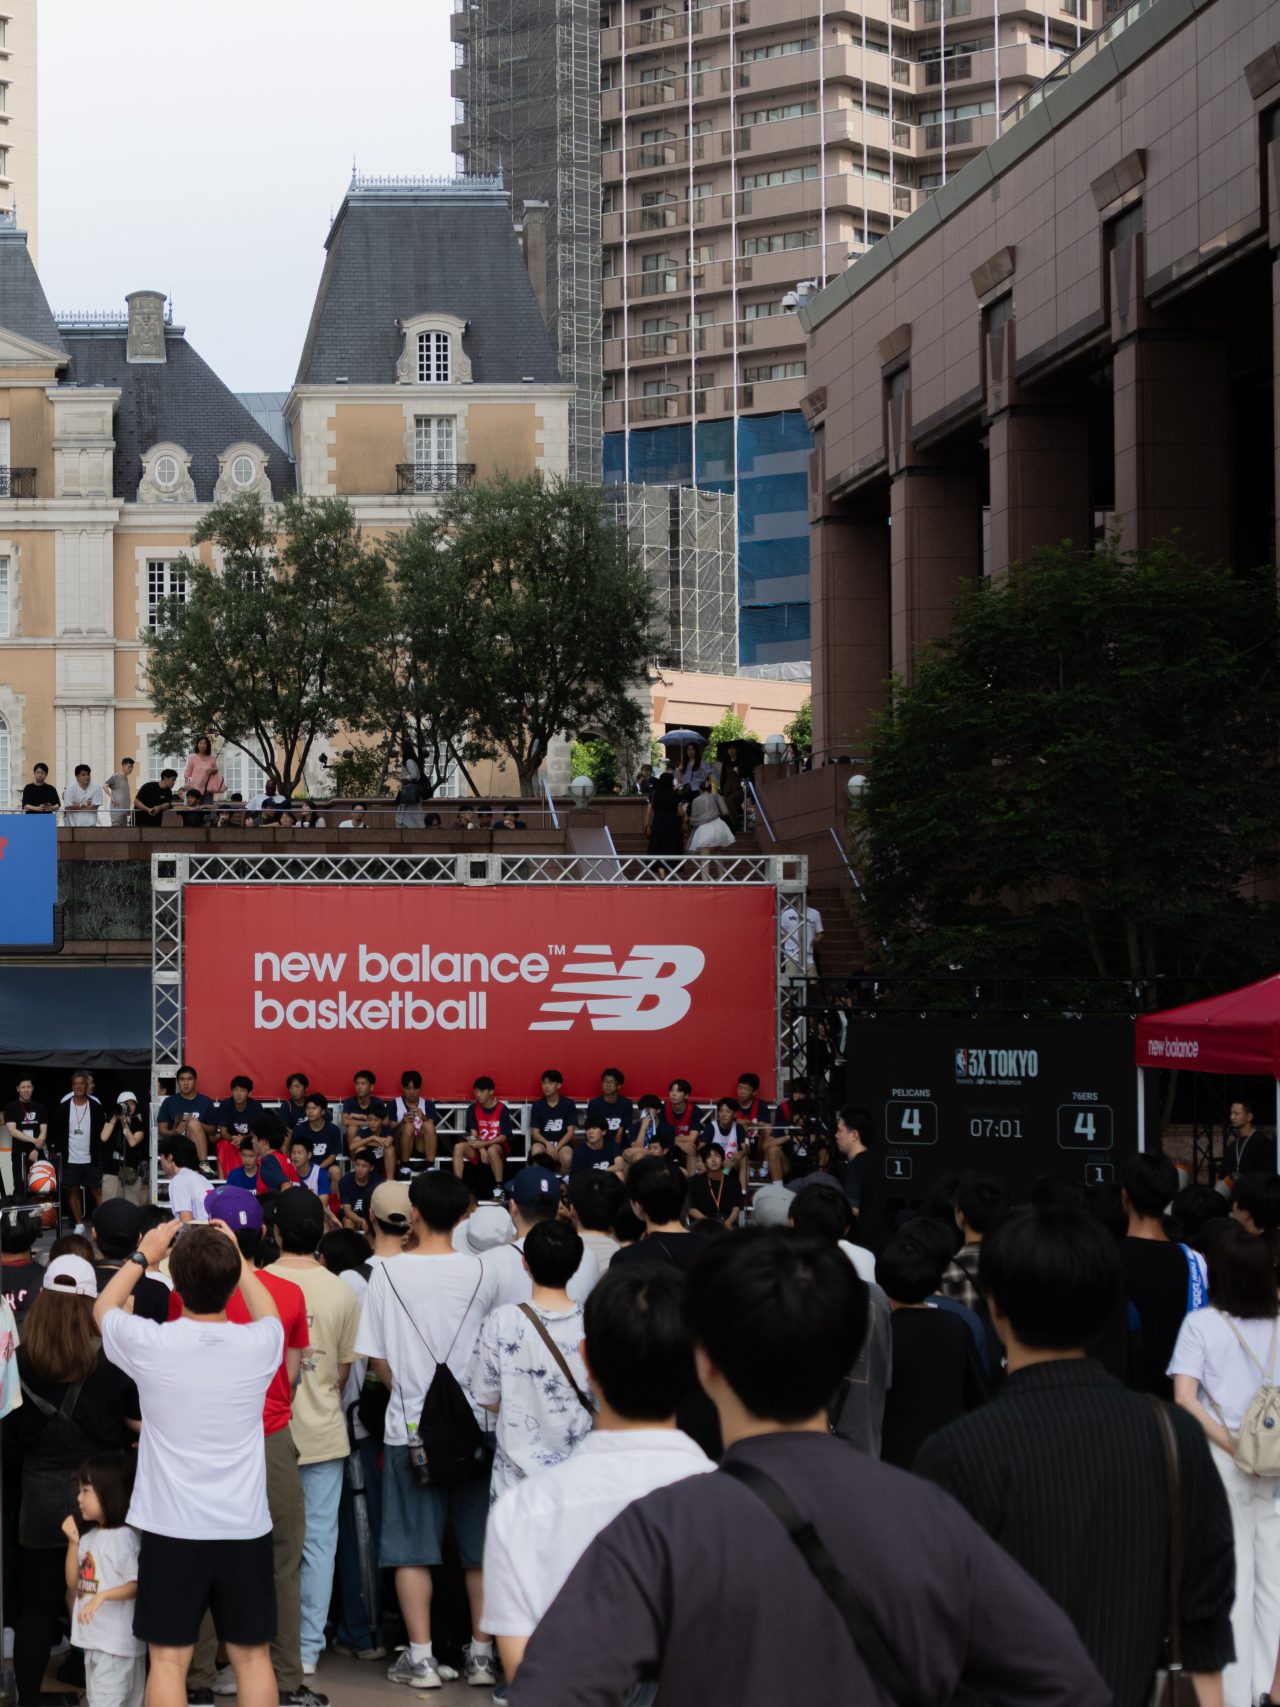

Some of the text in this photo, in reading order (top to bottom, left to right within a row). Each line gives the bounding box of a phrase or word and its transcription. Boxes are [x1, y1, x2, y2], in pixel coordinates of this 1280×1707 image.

[254, 951, 347, 983] new
[254, 991, 487, 1031] basketball
[1148, 1036, 1200, 1058] new balance
[968, 1049, 1038, 1078] 3X TOKYO
[891, 1088, 931, 1098] PELICANS
[1072, 1091, 1099, 1101] 76ERS
[901, 1108, 922, 1136] 4
[970, 1118, 1024, 1138] 07:01
[1074, 1112, 1096, 1141] 4
[895, 1160, 903, 1175] 1
[1095, 1167, 1104, 1182] 1
